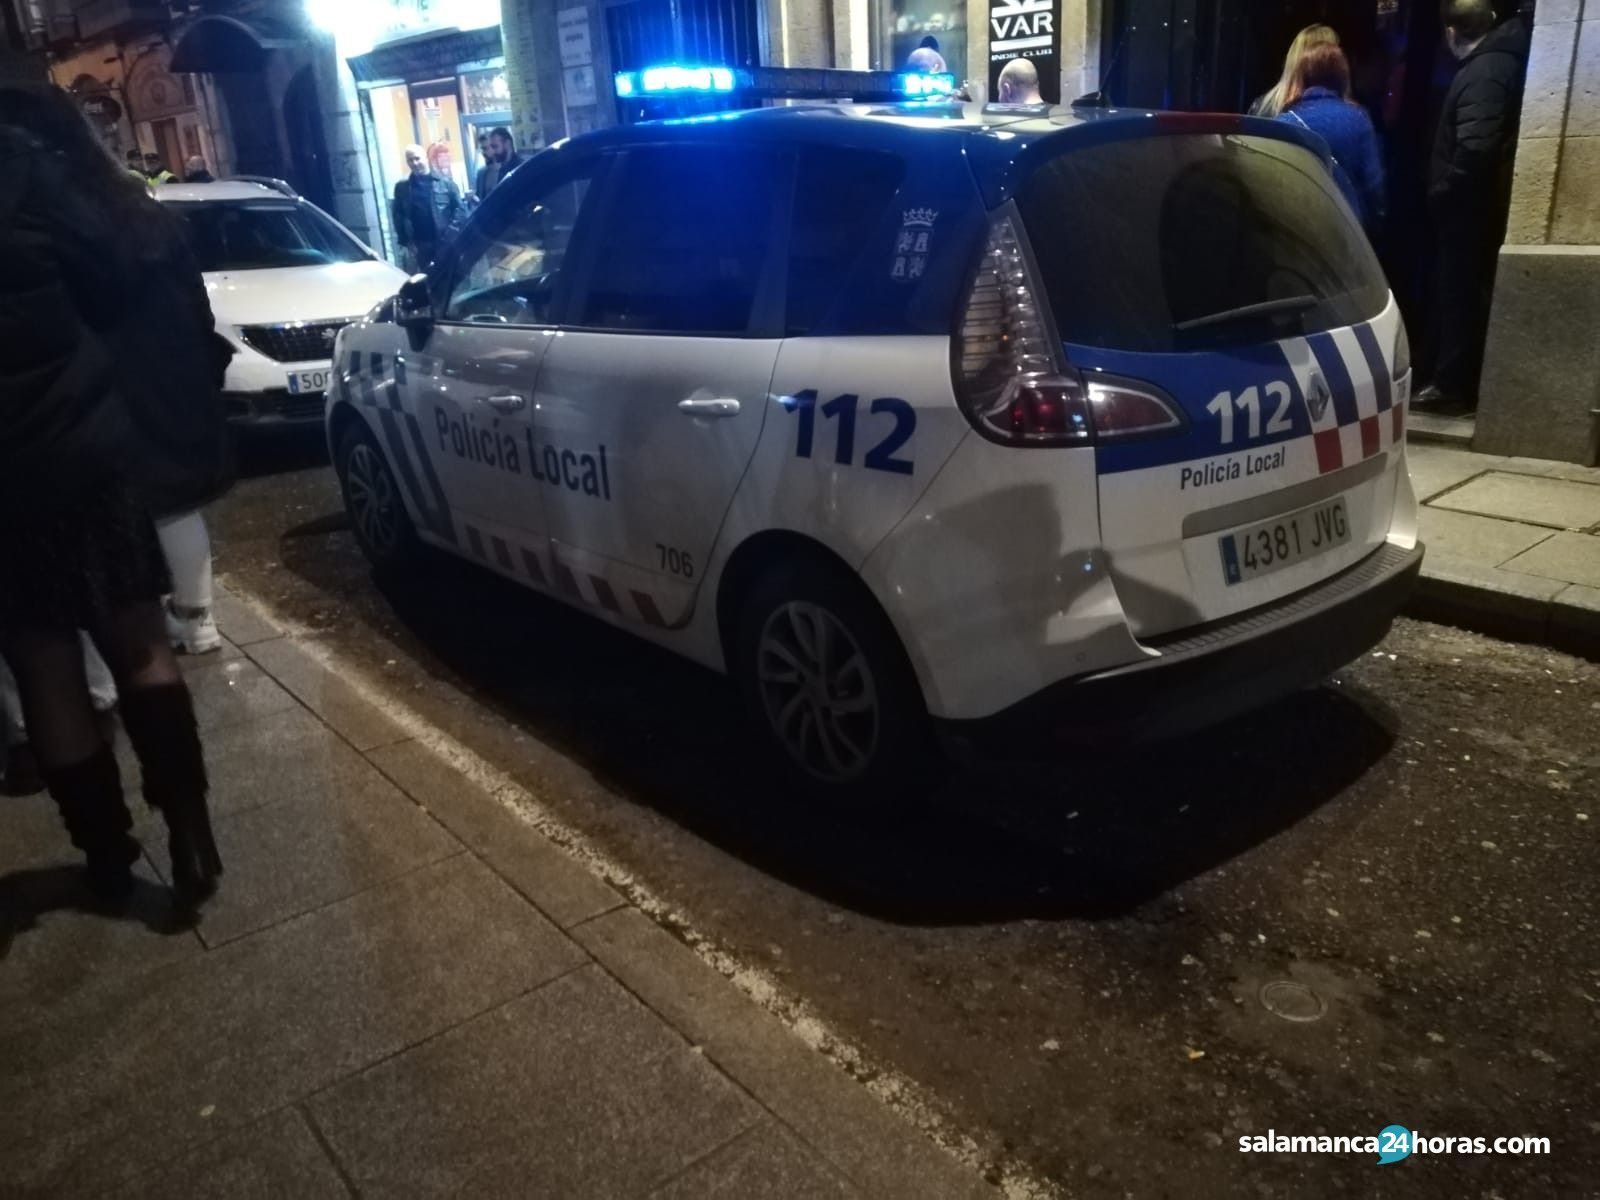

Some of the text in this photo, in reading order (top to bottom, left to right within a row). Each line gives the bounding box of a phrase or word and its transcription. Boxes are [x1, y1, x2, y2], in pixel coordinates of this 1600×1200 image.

[991, 11, 1054, 39] VAR
[1022, 48, 1052, 58] CLUB
[784, 389, 917, 475] 112
[1206, 380, 1293, 444] 112
[434, 405, 611, 501] Policía Local
[1180, 446, 1286, 490] Policía Local
[655, 542, 695, 579] 706
[1243, 504, 1346, 571] 4381 JVG
